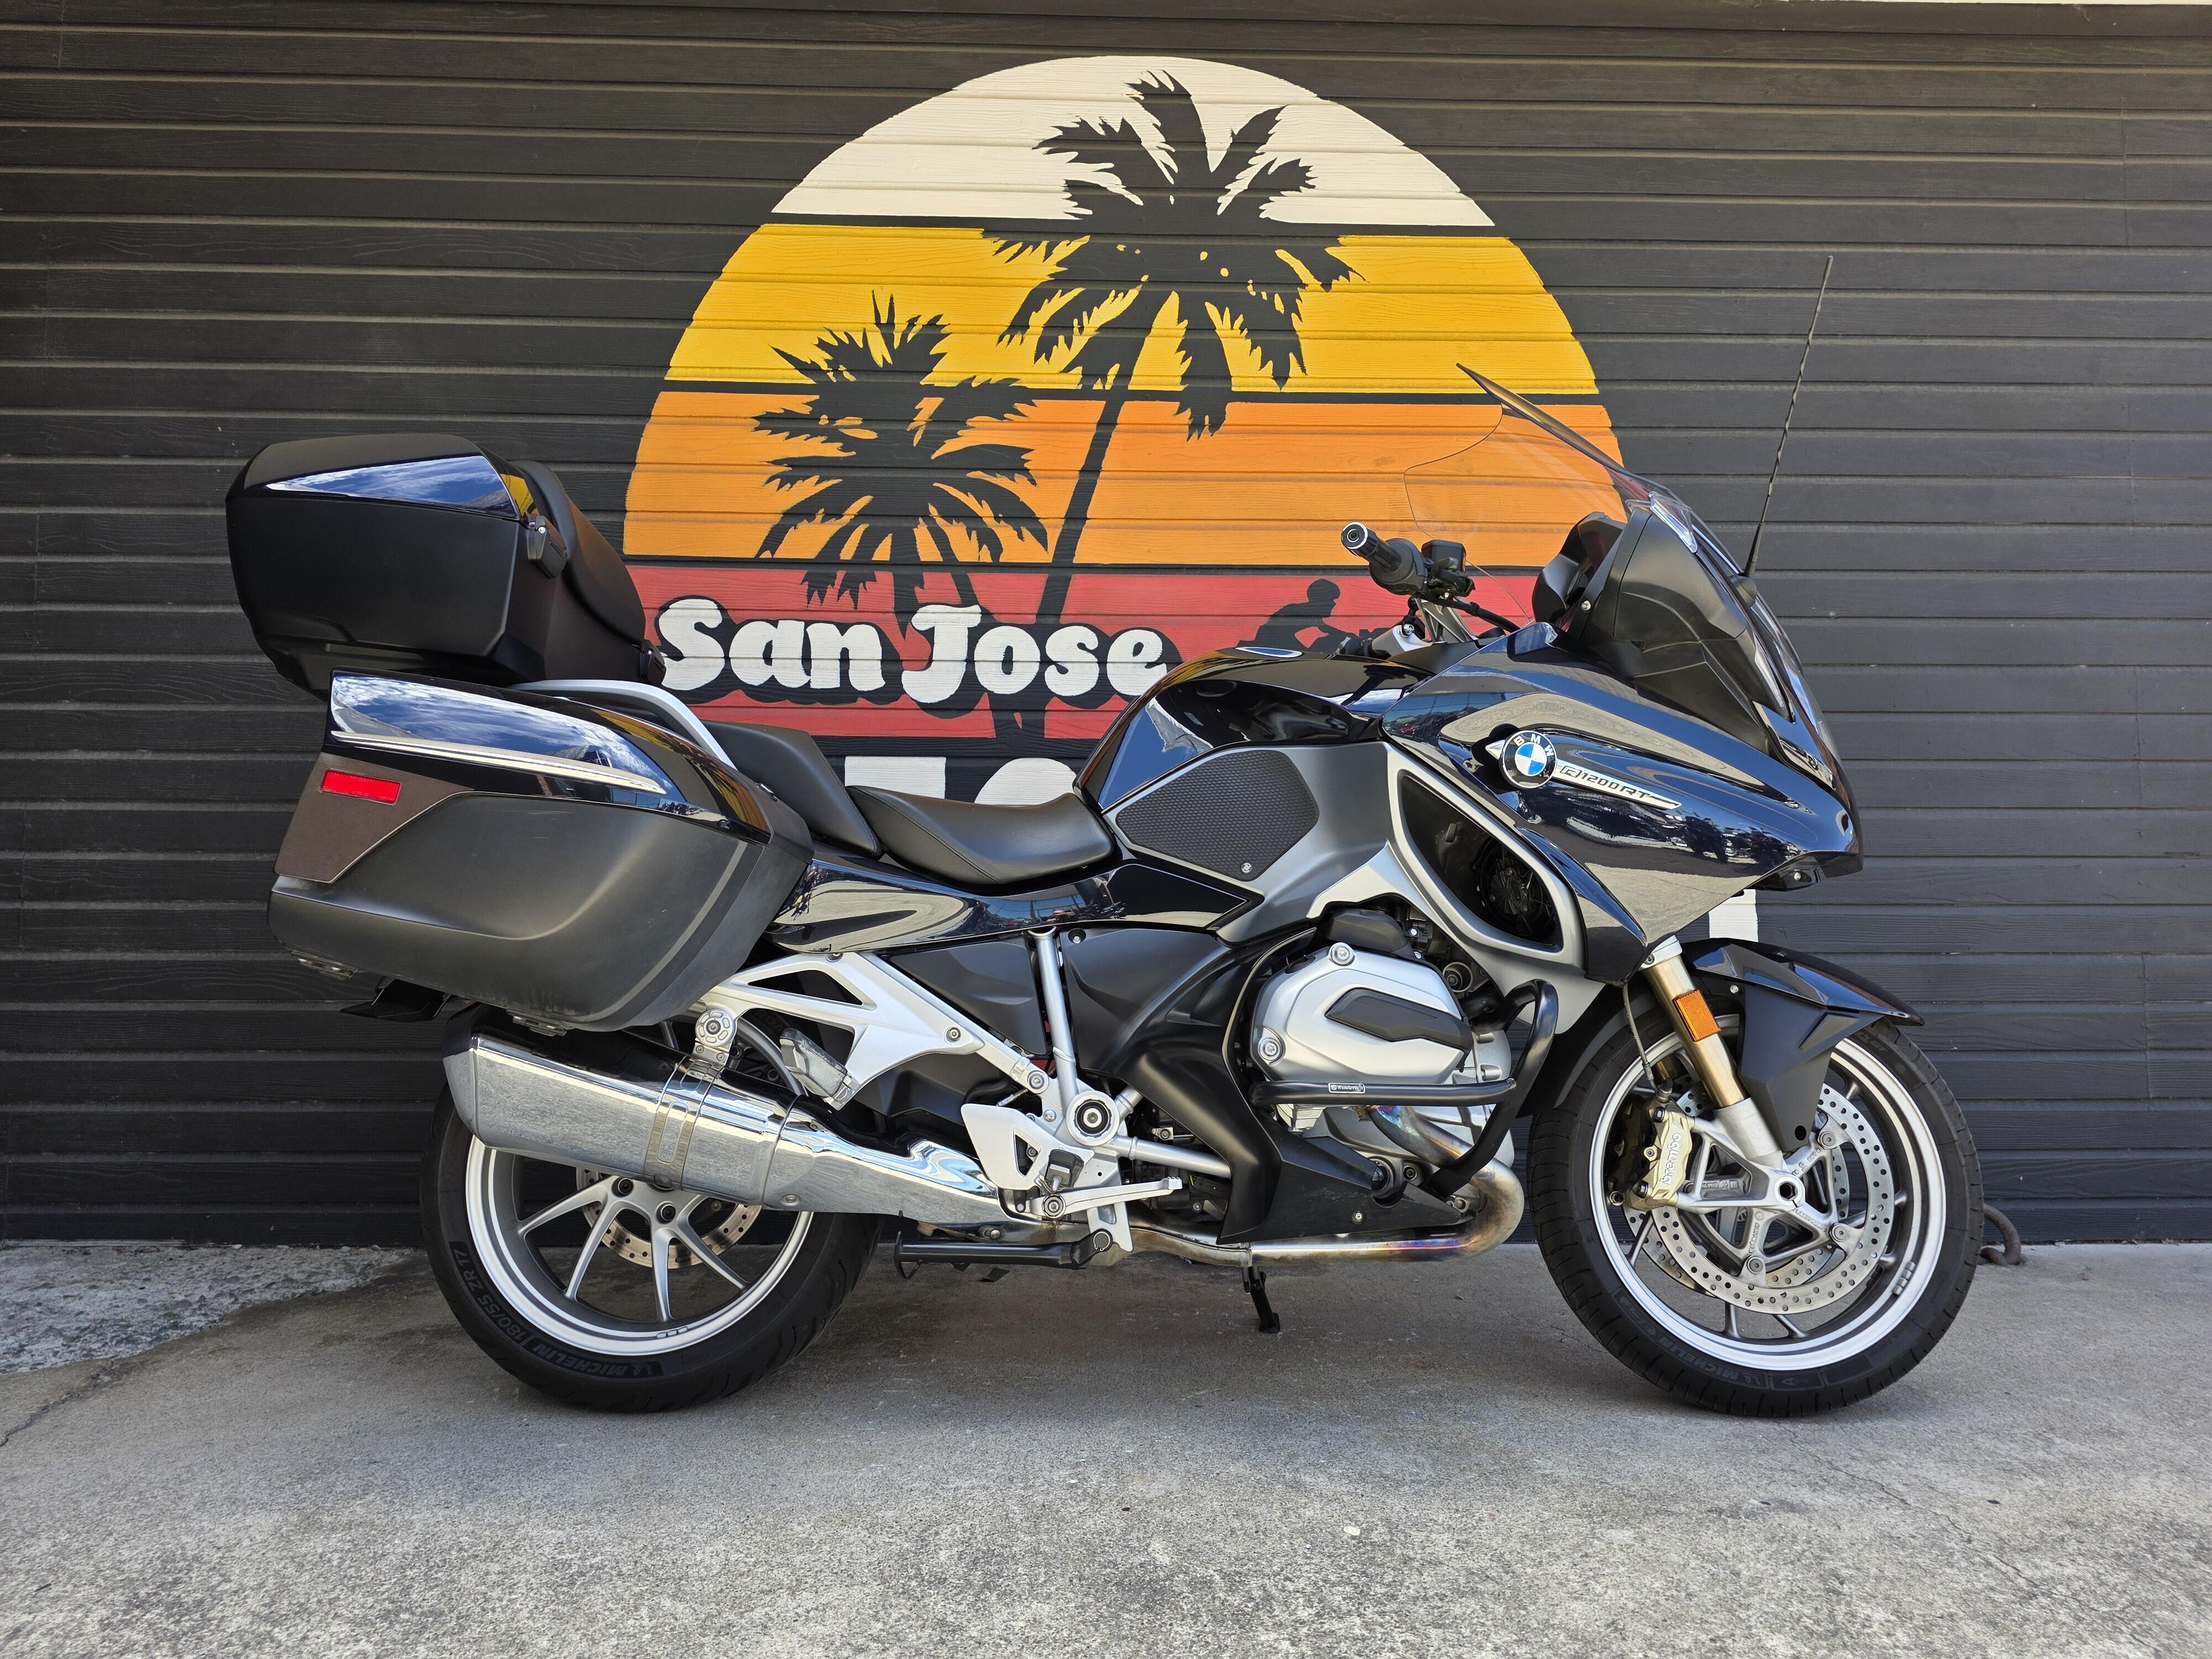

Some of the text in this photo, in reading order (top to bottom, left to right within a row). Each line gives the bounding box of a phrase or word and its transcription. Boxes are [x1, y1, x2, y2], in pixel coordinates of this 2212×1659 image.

[659, 598, 1168, 703] San Jose
[1514, 733, 1554, 757] BMW
[1660, 1133, 1681, 1185] brembo
[453, 1249, 525, 1340] 180/55 ZR 17
[532, 1343, 629, 1376] MICHELIN
[1660, 1336, 1740, 1381] MICHELIN
